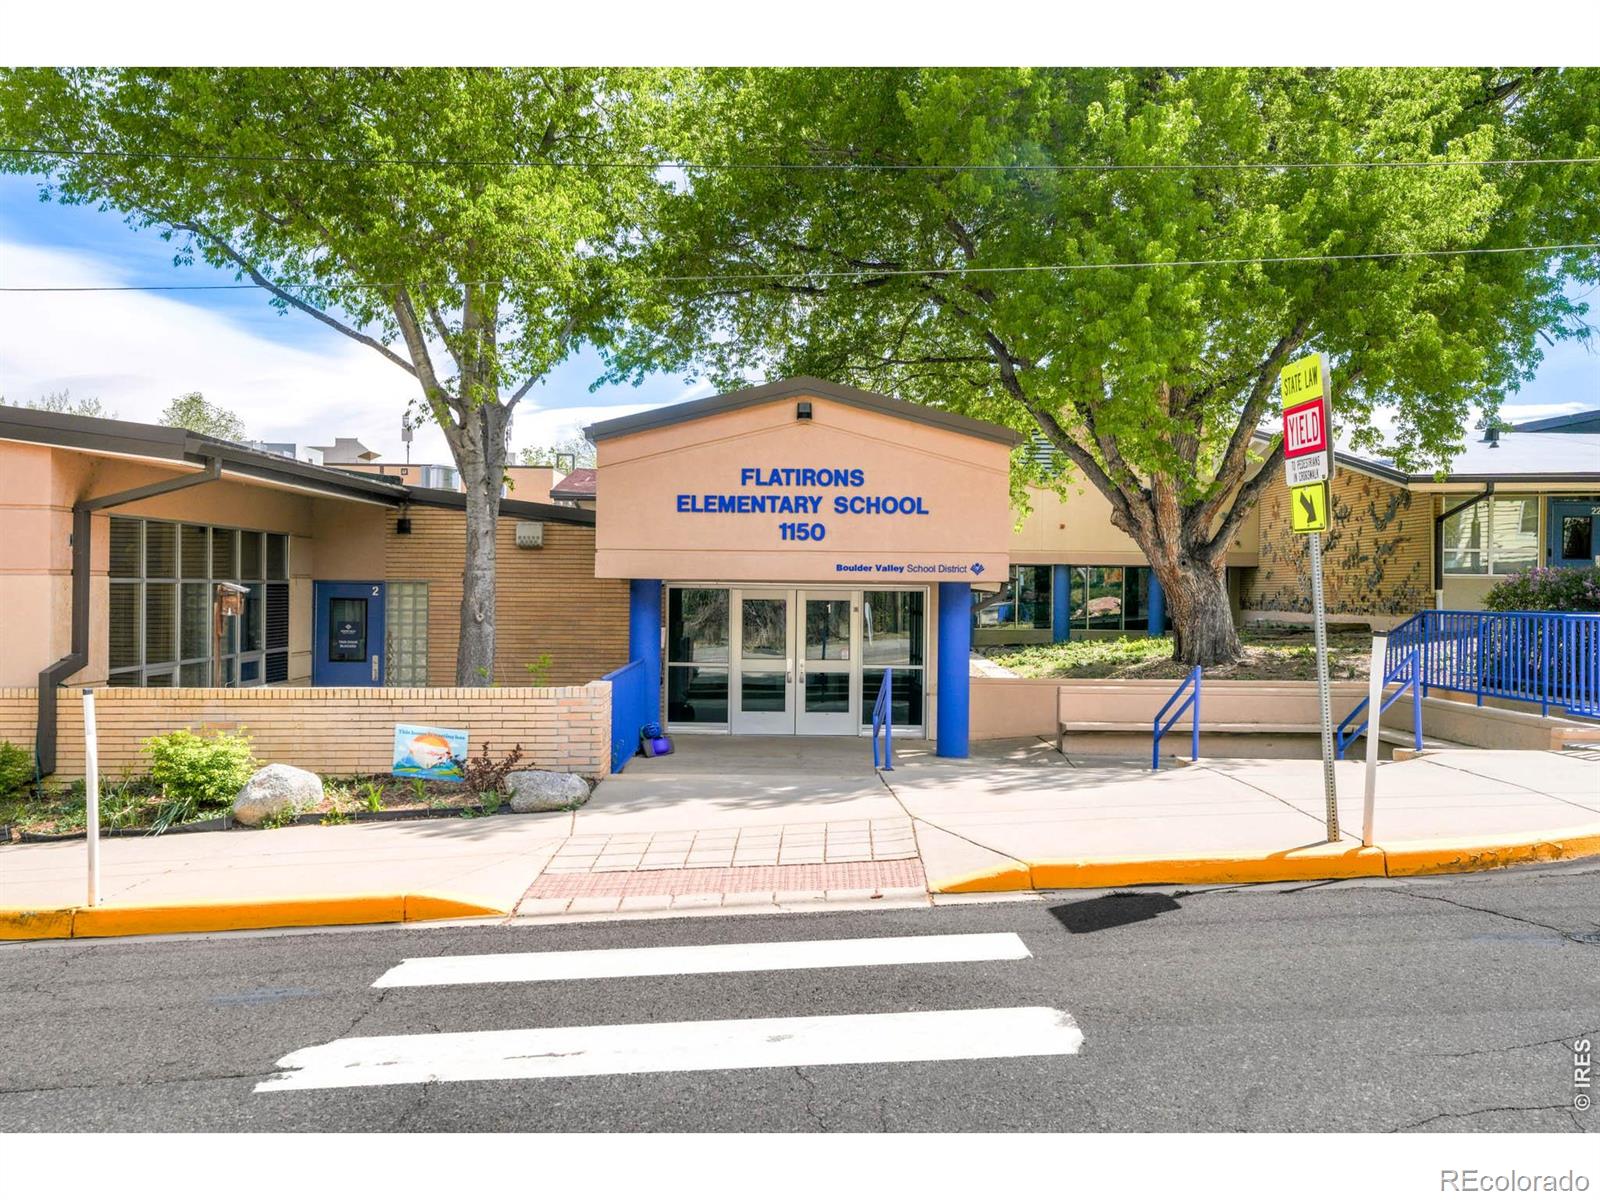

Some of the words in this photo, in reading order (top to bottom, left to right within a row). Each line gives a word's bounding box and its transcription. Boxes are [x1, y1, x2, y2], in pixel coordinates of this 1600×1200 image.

[1283, 373, 1302, 396] STATE
[1304, 366, 1318, 388] LAW
[1288, 411, 1319, 447] YIELD
[740, 468, 865, 487] FLATIRONS
[676, 494, 823, 514] ELEMENTARY
[833, 496, 929, 515] SCHOOL
[778, 522, 826, 542] 1150
[836, 564, 873, 572] Boulder
[875, 564, 904, 574] Valley
[906, 564, 936, 573] School
[938, 564, 967, 573] District
[372, 586, 379, 596] 2
[826, 603, 831, 614] 1
